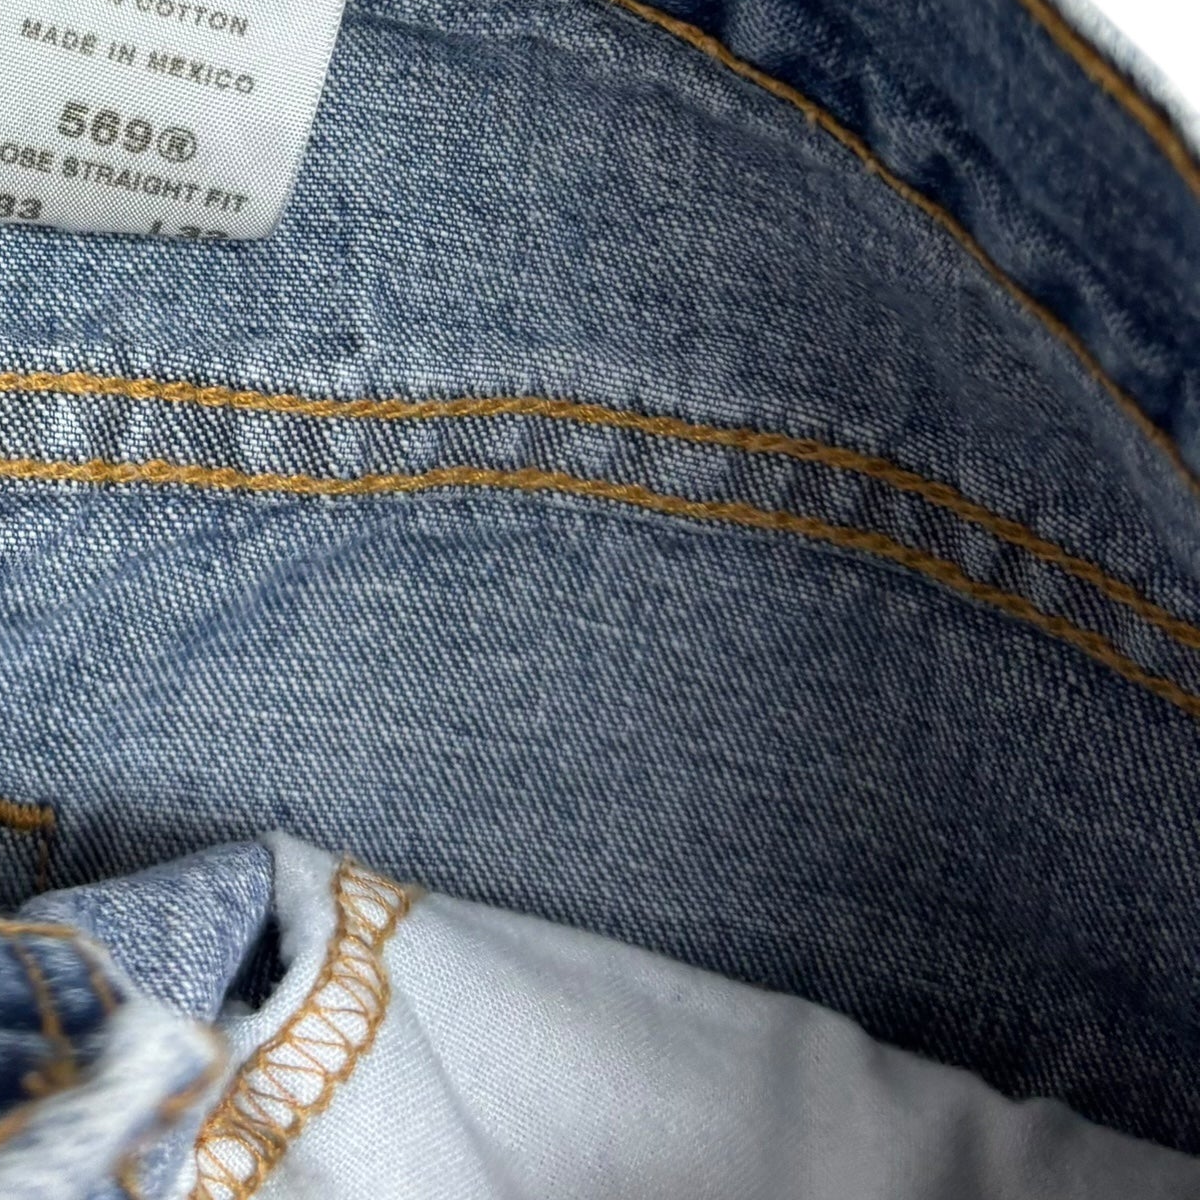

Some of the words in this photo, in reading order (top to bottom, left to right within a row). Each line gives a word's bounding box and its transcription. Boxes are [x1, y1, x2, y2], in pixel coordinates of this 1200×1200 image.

[21, 17, 97, 56] MADE
[107, 40, 136, 66] IN
[147, 50, 255, 95] MEXICO
[62, 154, 198, 202] STRAIGHT
[204, 184, 248, 214] FIT
